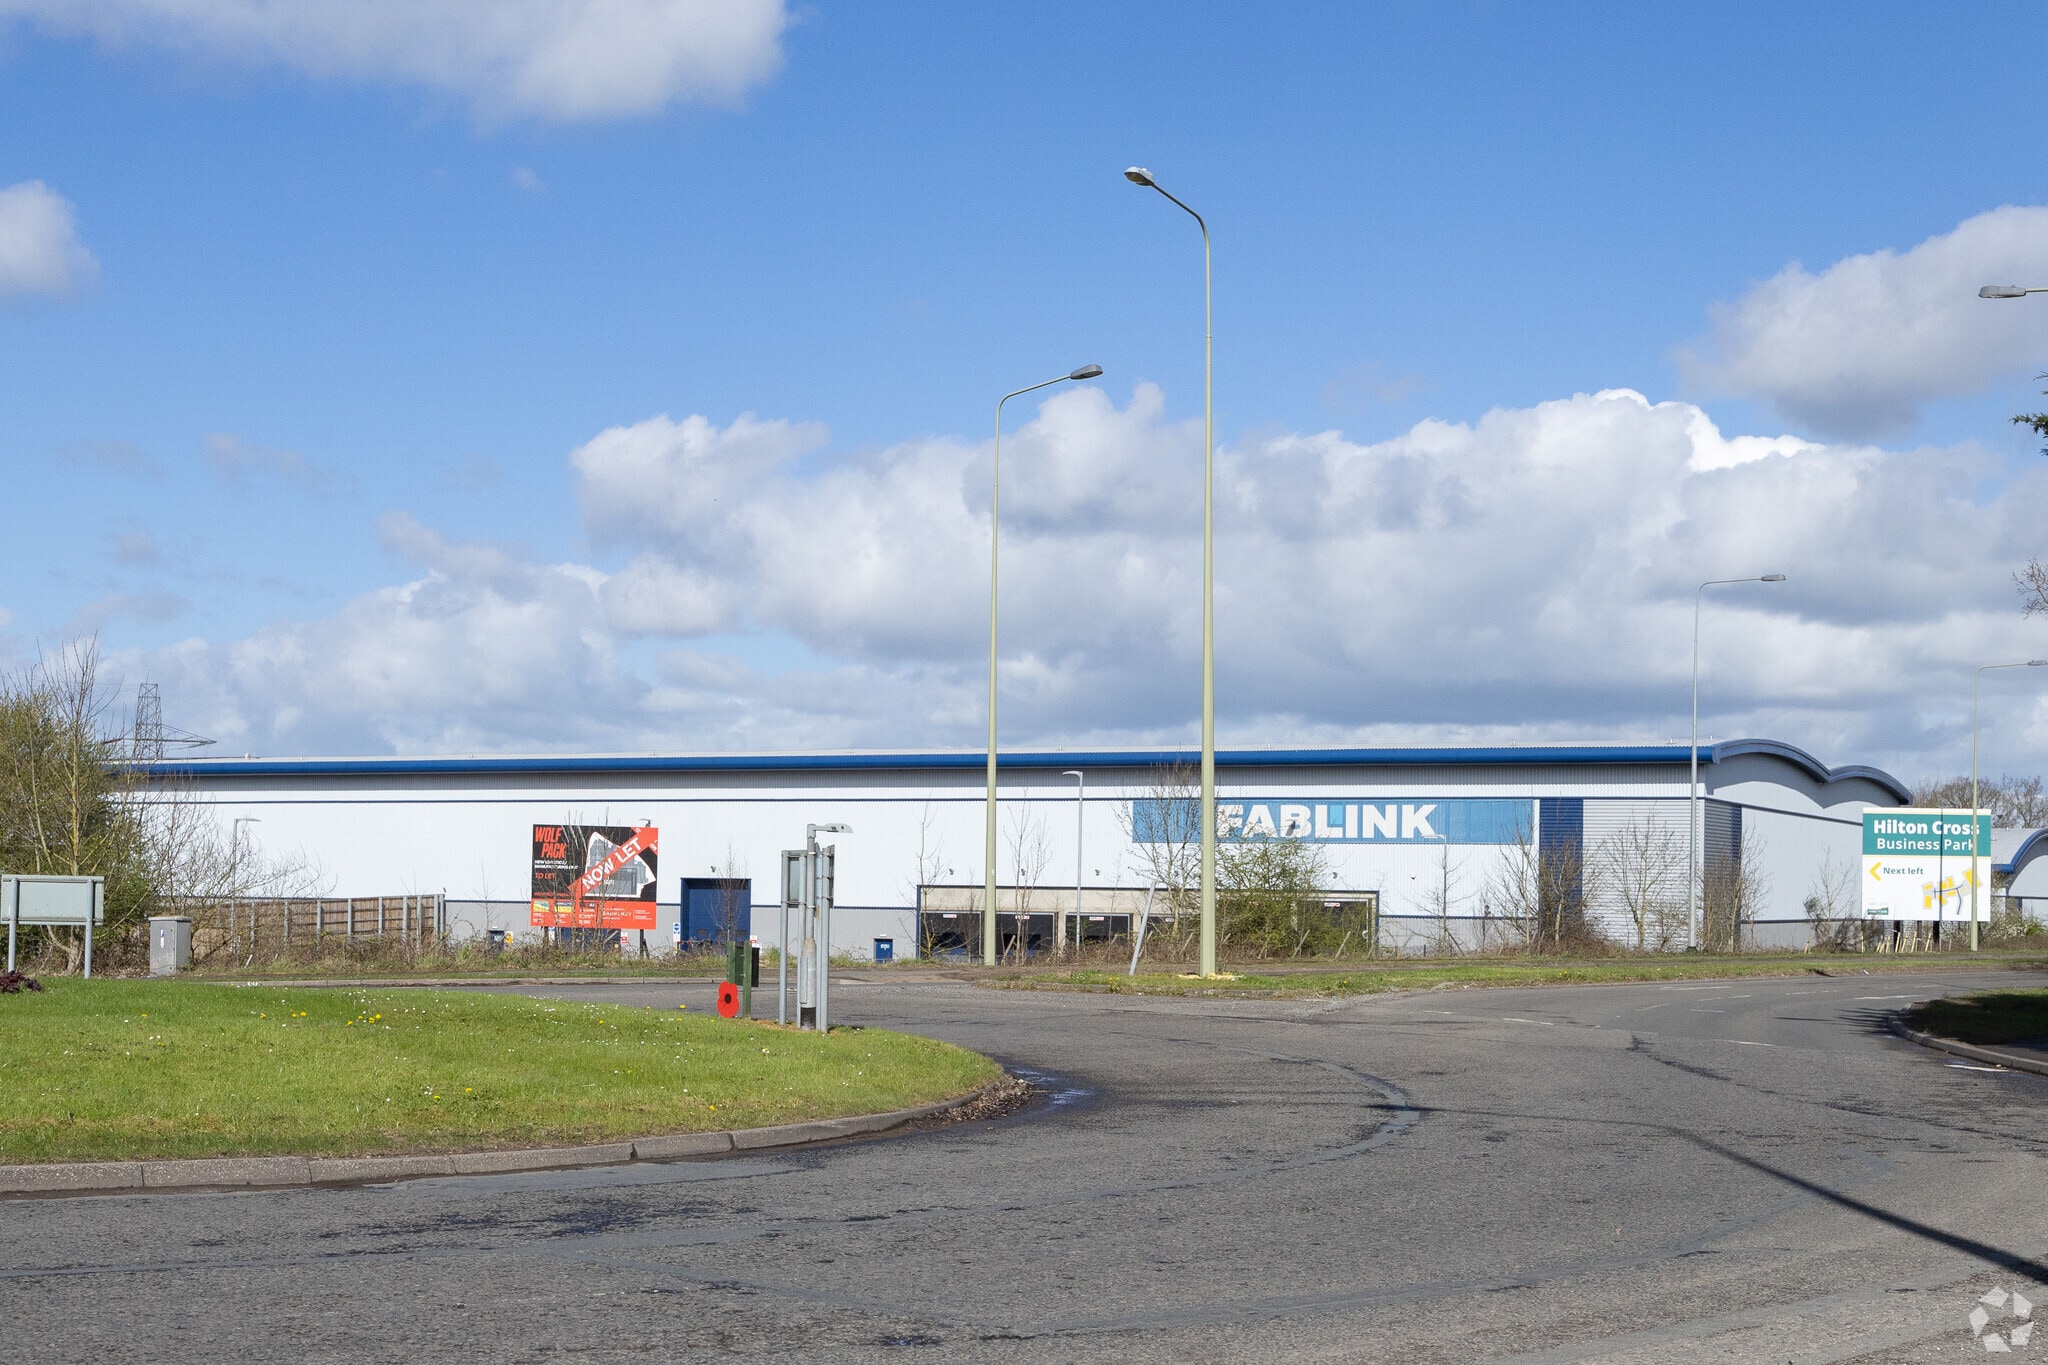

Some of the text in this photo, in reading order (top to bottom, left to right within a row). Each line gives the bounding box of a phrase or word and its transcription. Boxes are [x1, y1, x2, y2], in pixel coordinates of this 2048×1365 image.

[1215, 804, 1438, 839] FABLINK
[1873, 819, 1928, 835] Hilton
[535, 827, 562, 843] WOLF
[541, 843, 566, 858] PACK
[1876, 837, 1940, 850] Business
[582, 858, 615, 890] NOW
[615, 837, 642, 863] LET
[1883, 867, 1924, 875] Next left
